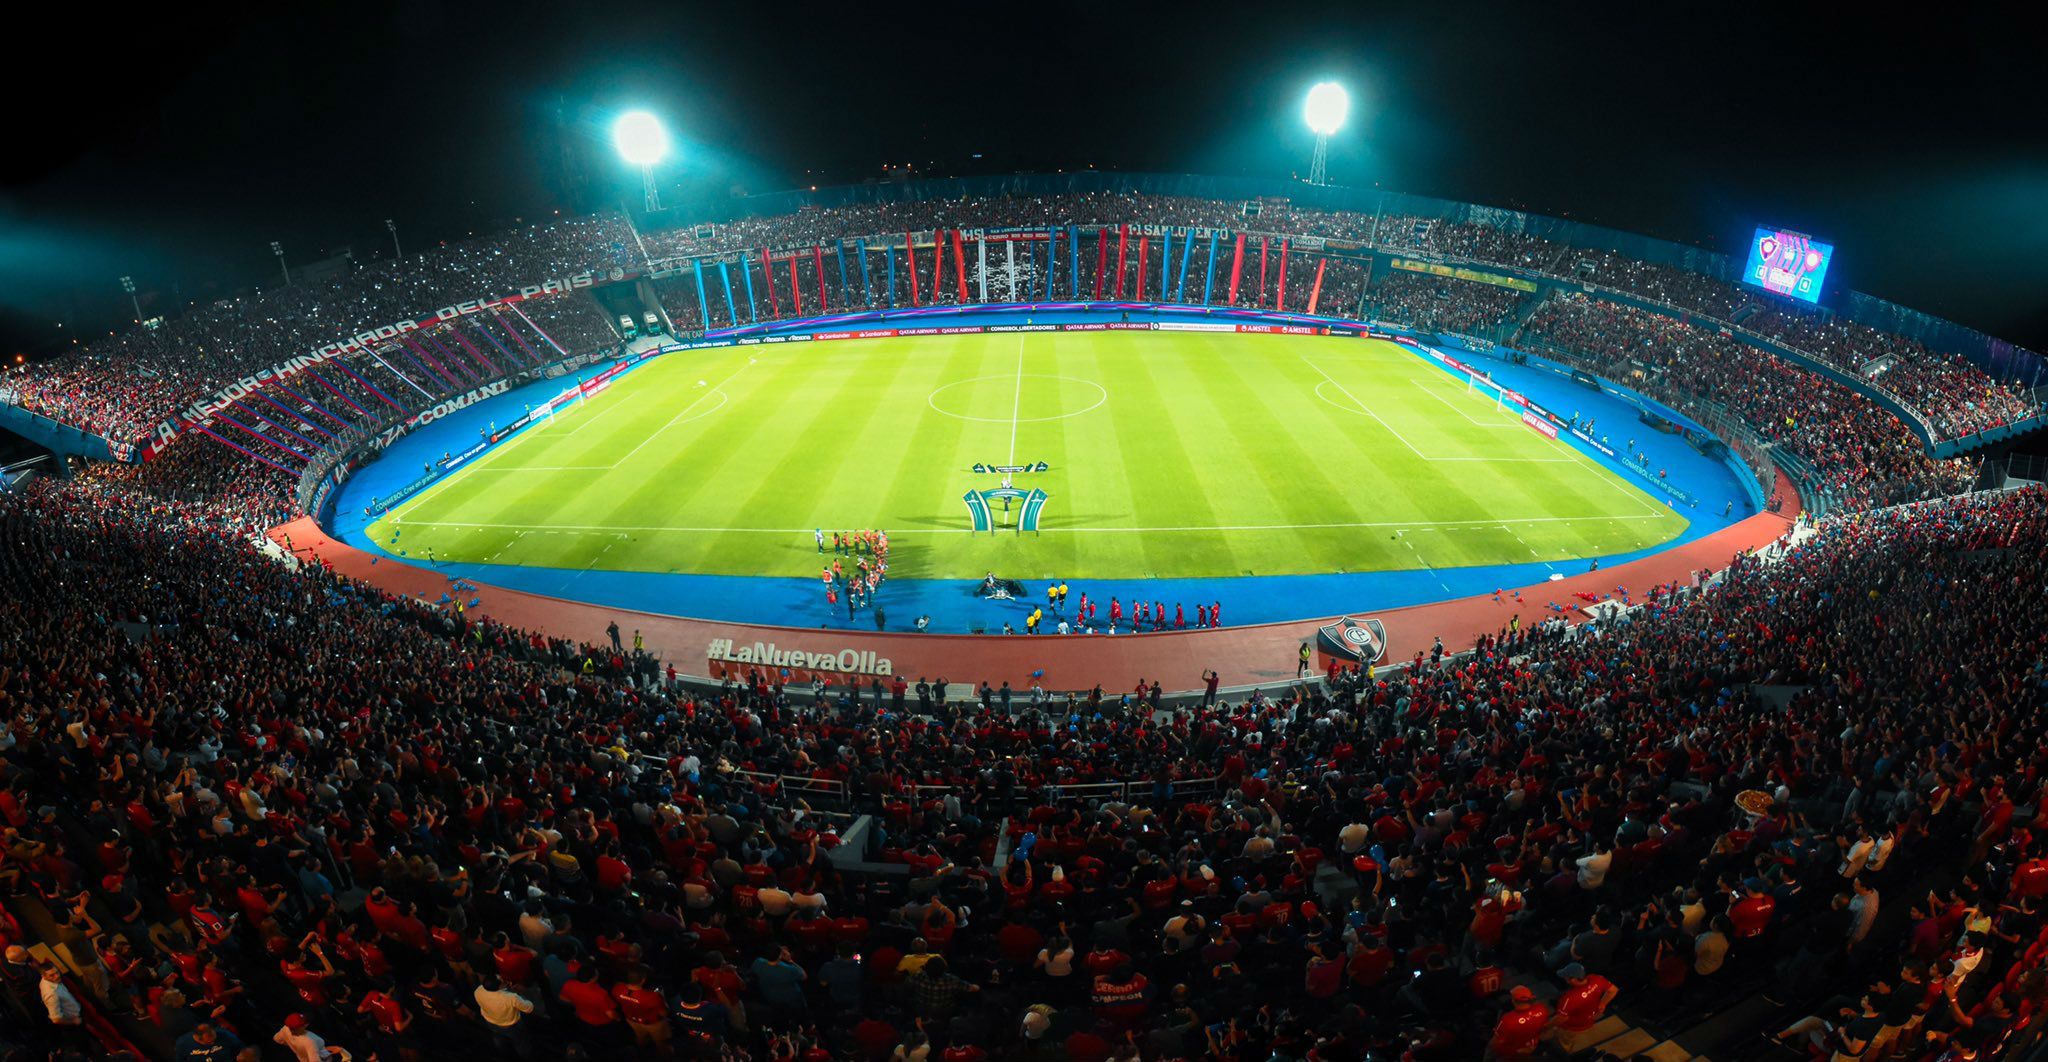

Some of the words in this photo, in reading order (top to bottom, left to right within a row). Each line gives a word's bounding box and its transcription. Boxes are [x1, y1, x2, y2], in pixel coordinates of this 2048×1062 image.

[865, 330, 892, 338] Santander
[1288, 326, 1311, 334] AMSTEL
[662, 343, 691, 353] CONMEBOL
[151, 420, 176, 455] LA
[181, 375, 263, 424] MEJOR
[272, 319, 419, 380] HINCHADA
[436, 297, 502, 321] DEL
[520, 272, 593, 300] PAIS
[1621, 456, 1649, 479] CONMEBOL
[1648, 473, 1661, 486] Cree
[1667, 484, 1687, 501] grande
[375, 490, 404, 512] CONMEBOL
[707, 638, 892, 676] #LaNuevaOlla
[1480, 976, 1499, 993] 10
